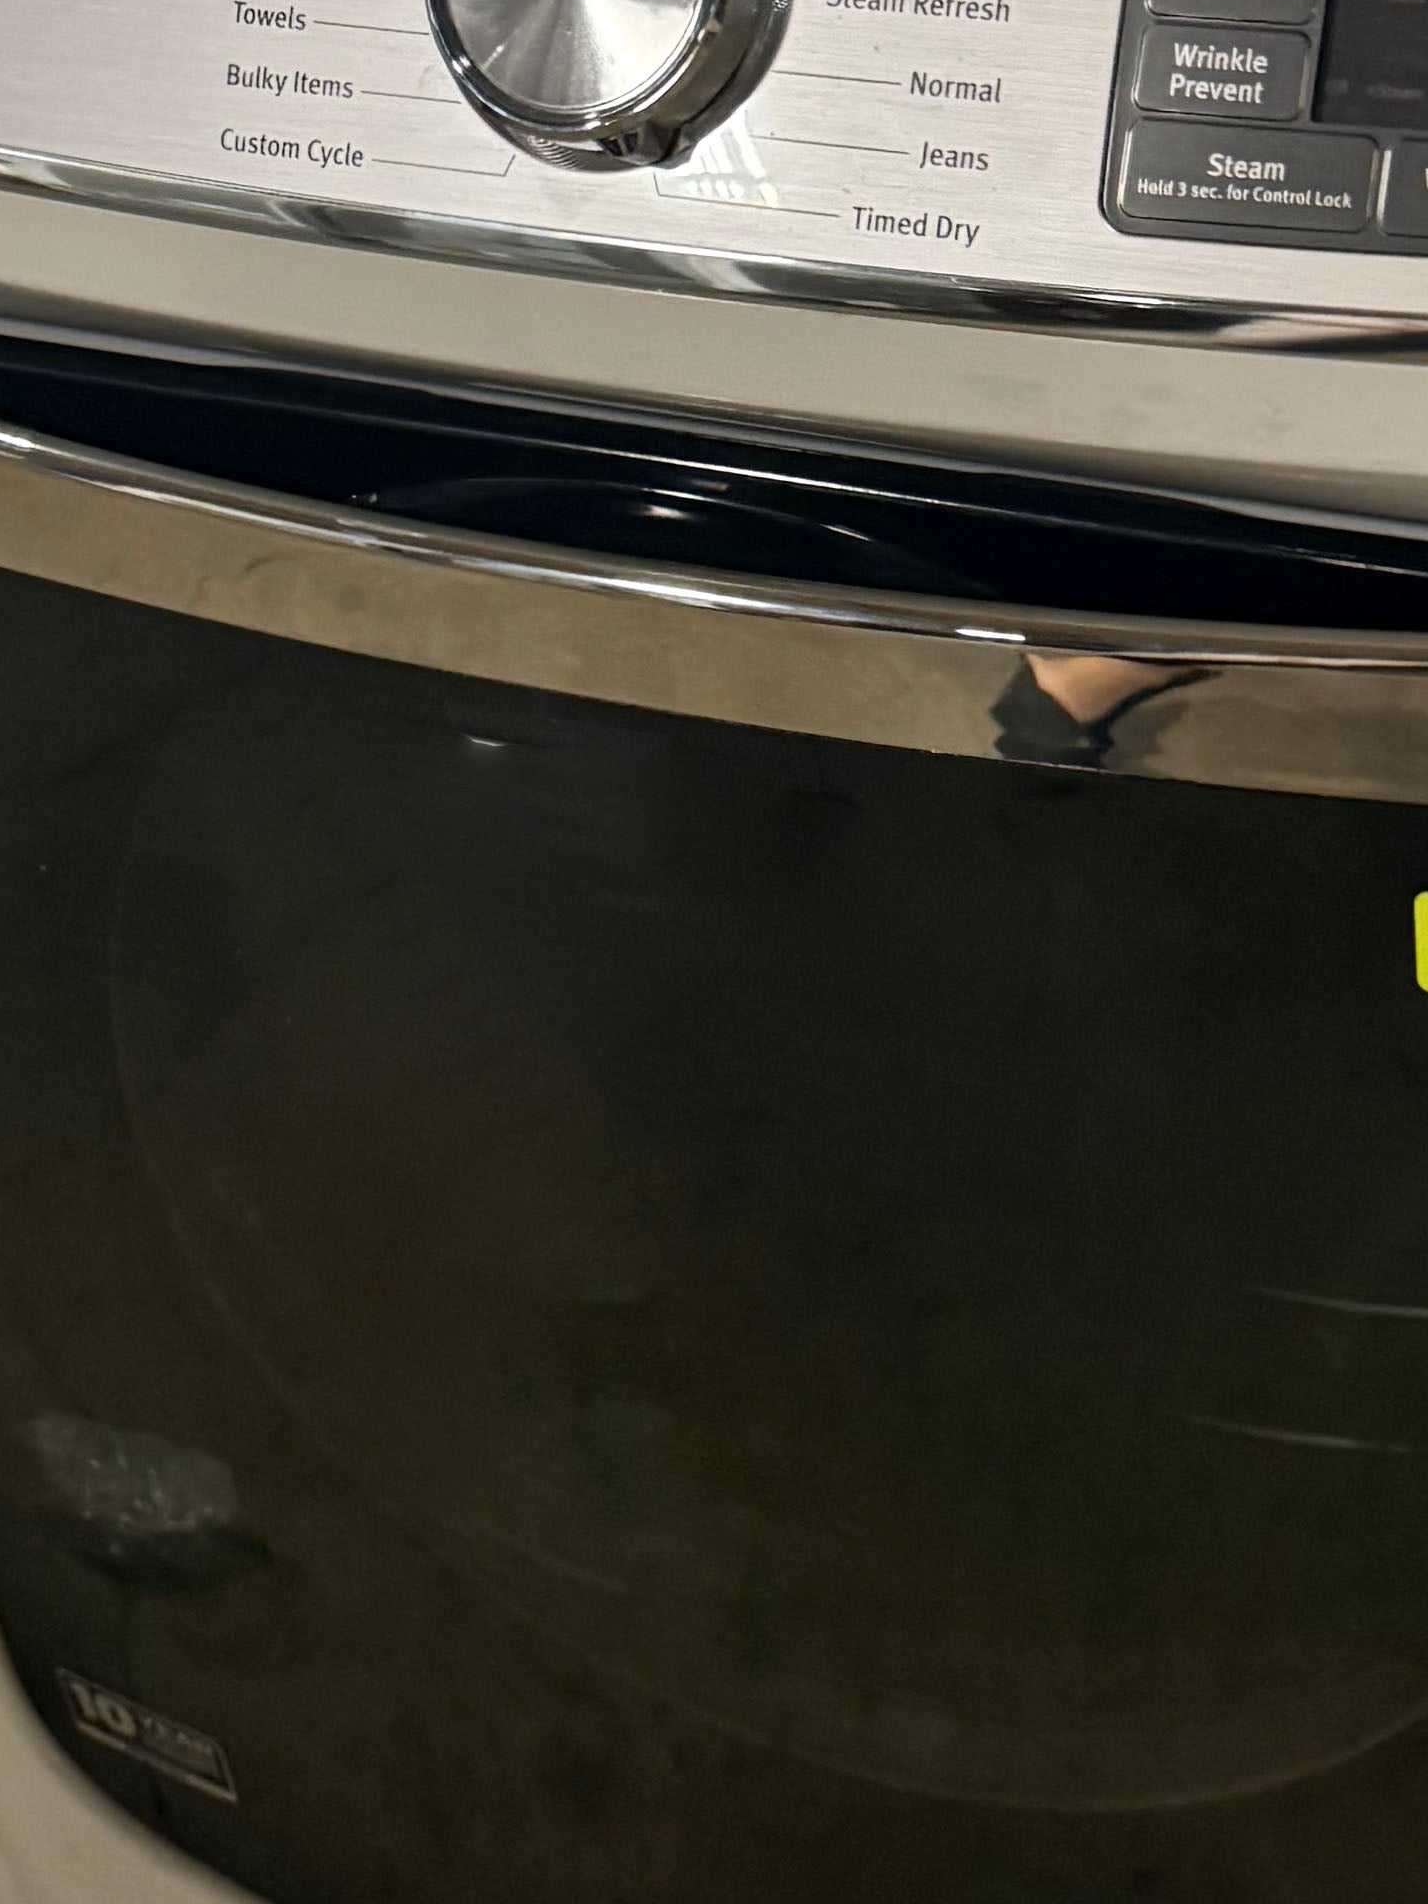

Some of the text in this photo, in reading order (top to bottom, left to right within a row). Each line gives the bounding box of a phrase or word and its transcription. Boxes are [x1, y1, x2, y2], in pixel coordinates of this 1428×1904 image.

[233, 1, 306, 31] Towels
[1173, 42, 1268, 74] Wrinkle
[226, 64, 354, 99] Bulky Items
[910, 71, 1002, 103] Normal
[1169, 74, 1264, 105] Prevent
[220, 129, 364, 168] Custom Cycle
[919, 141, 989, 171] Jeans
[1206, 152, 1286, 182] Steam
[1137, 178, 1353, 209] Hold 3 sec. for Control Lock
[852, 206, 980, 248] Timed Dry
